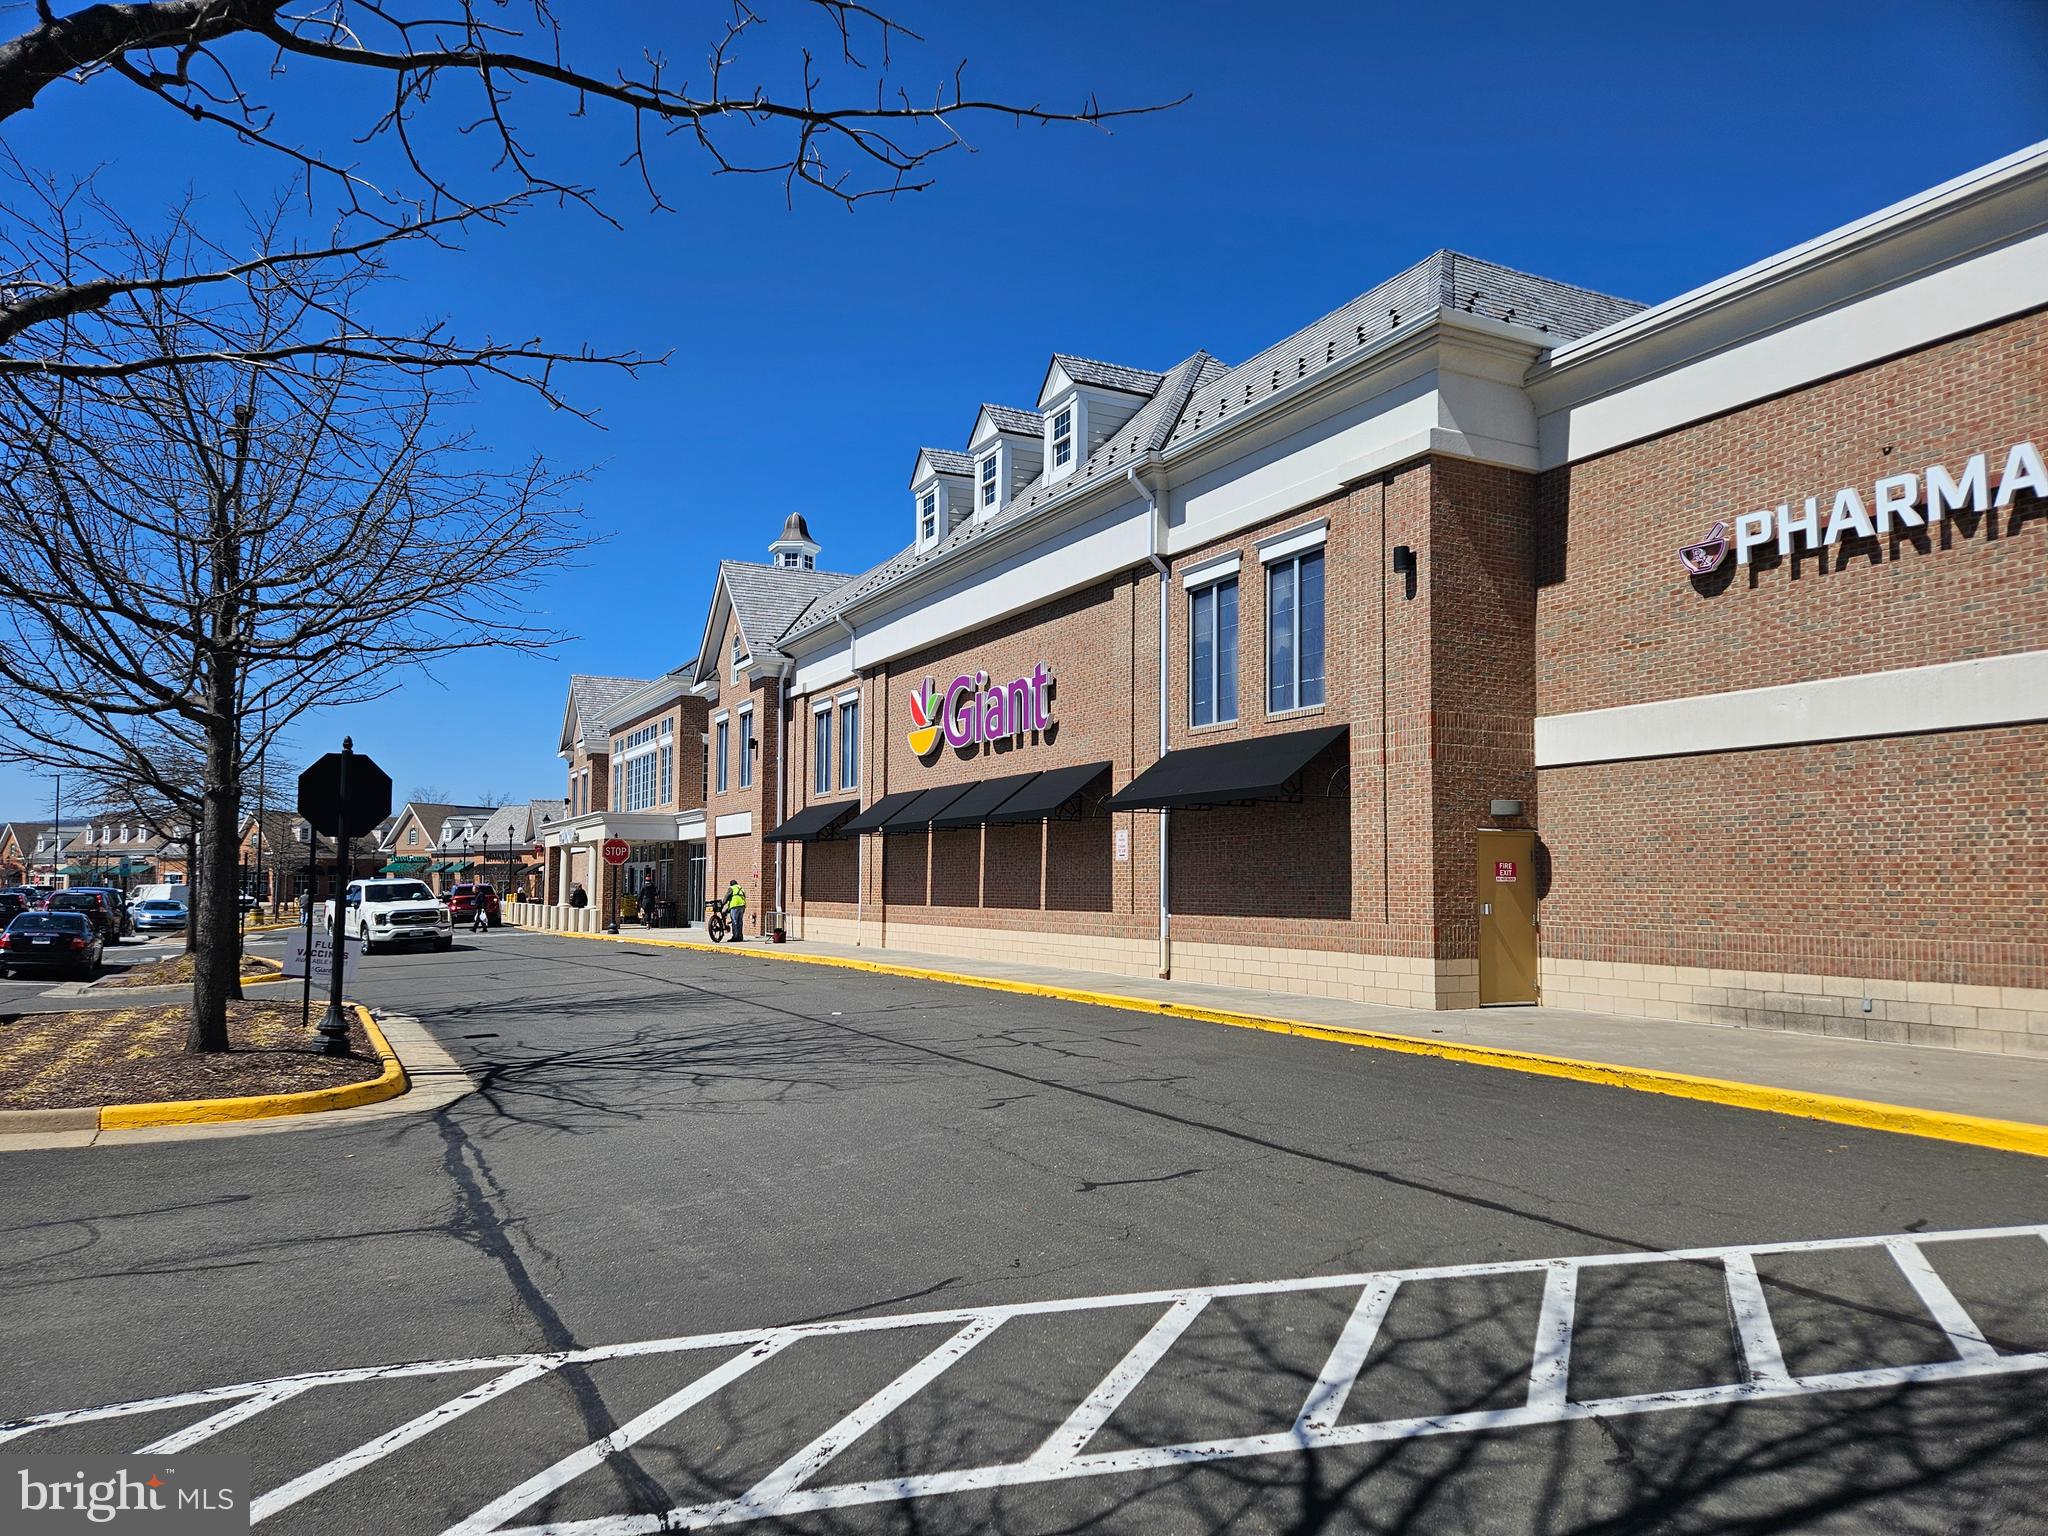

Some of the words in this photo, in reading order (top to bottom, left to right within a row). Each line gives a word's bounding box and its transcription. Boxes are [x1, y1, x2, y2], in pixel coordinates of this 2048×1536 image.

[943, 660, 1054, 749] Giant
[605, 846, 627, 856] STOP
[315, 940, 333, 949] FLU
[297, 948, 349, 960] VACCINS
